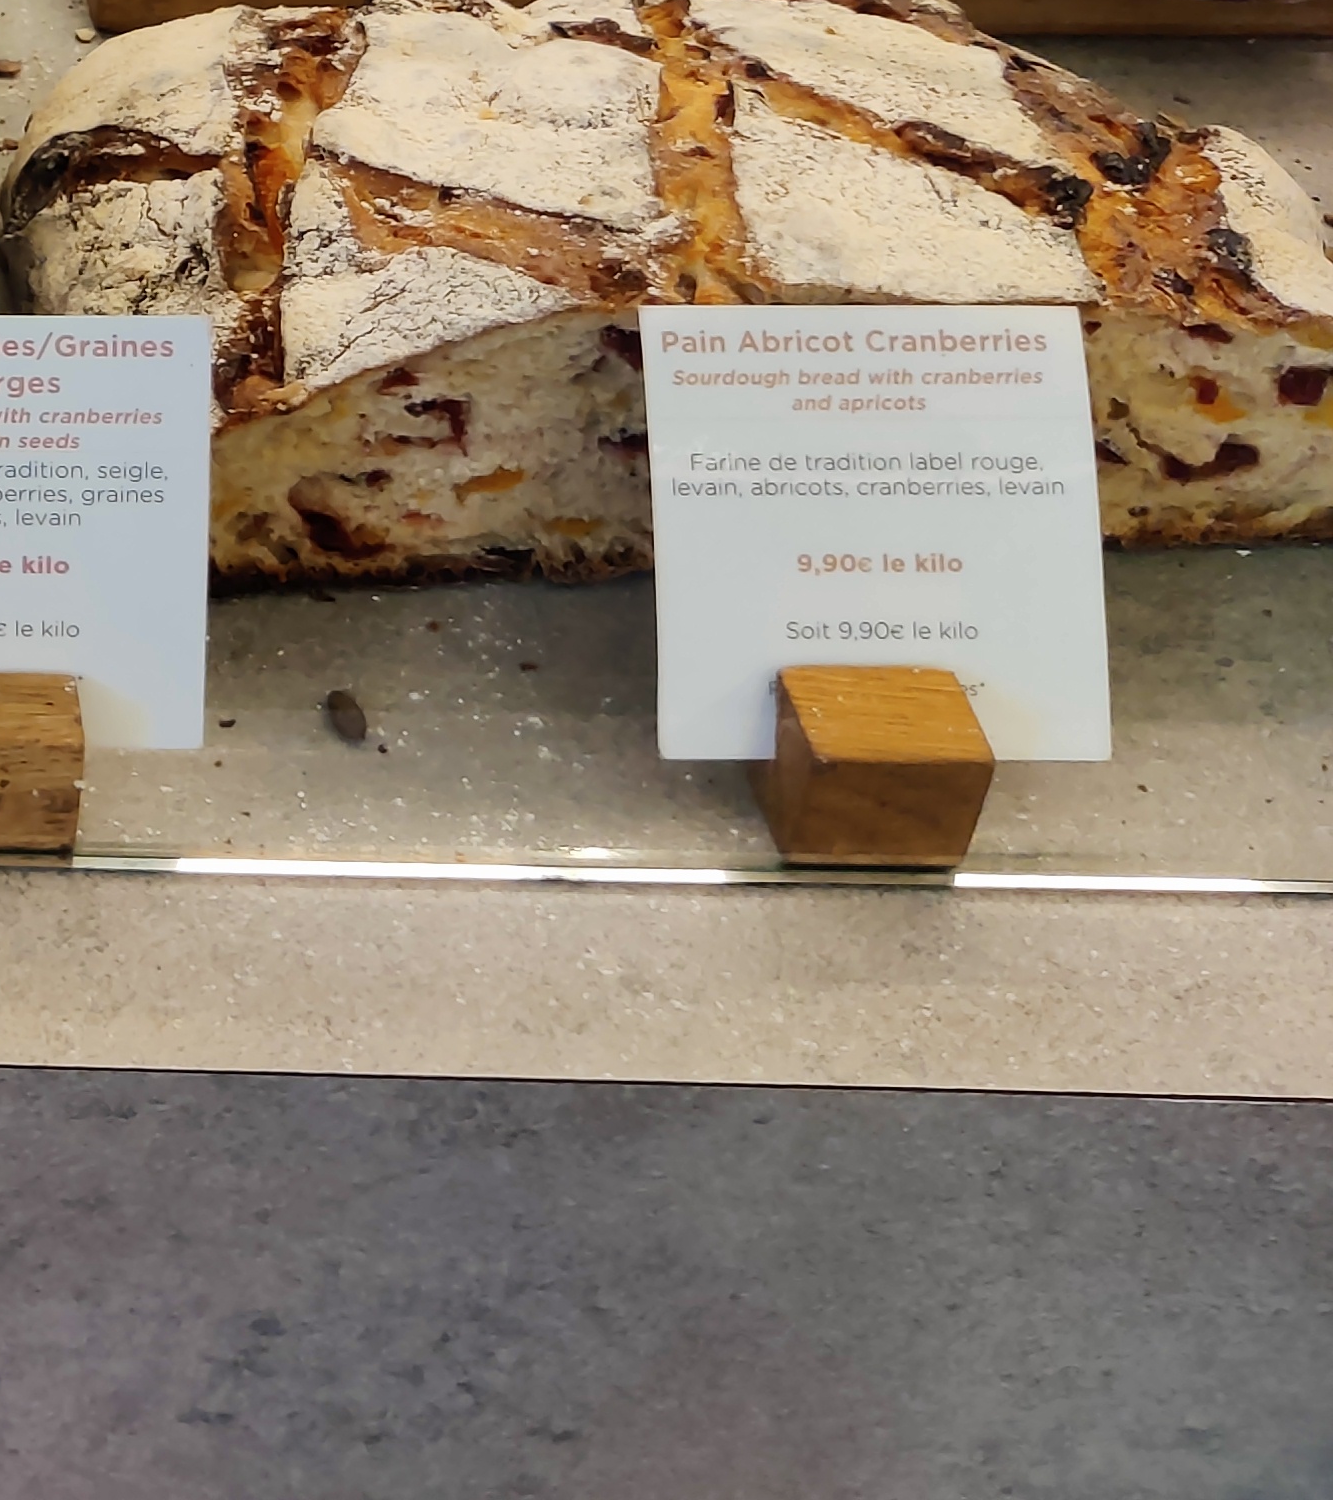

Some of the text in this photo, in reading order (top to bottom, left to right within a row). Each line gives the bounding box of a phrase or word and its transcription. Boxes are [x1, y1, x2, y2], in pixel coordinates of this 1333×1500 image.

[661, 328, 1048, 355] Pain Abricot Cranberries
[671, 367, 1043, 389] Sourdough bread with cranberries
[791, 394, 927, 415] and apricots
[38, 407, 163, 425] cranberries
[17, 432, 80, 449] seeds
[97, 461, 168, 483] seigle,
[690, 451, 1044, 475] Farine de tradition label rouge,
[81, 489, 164, 506] graines
[672, 477, 1065, 498] levain, abricots, cranberries, levain
[15, 507, 81, 527] levain
[21, 555, 70, 575] kilo
[796, 552, 963, 576] 9,90€ le kilo
[15, 620, 34, 638] le
[41, 620, 80, 638] kilo
[786, 620, 979, 641] Soit 9,90€ le kilo
